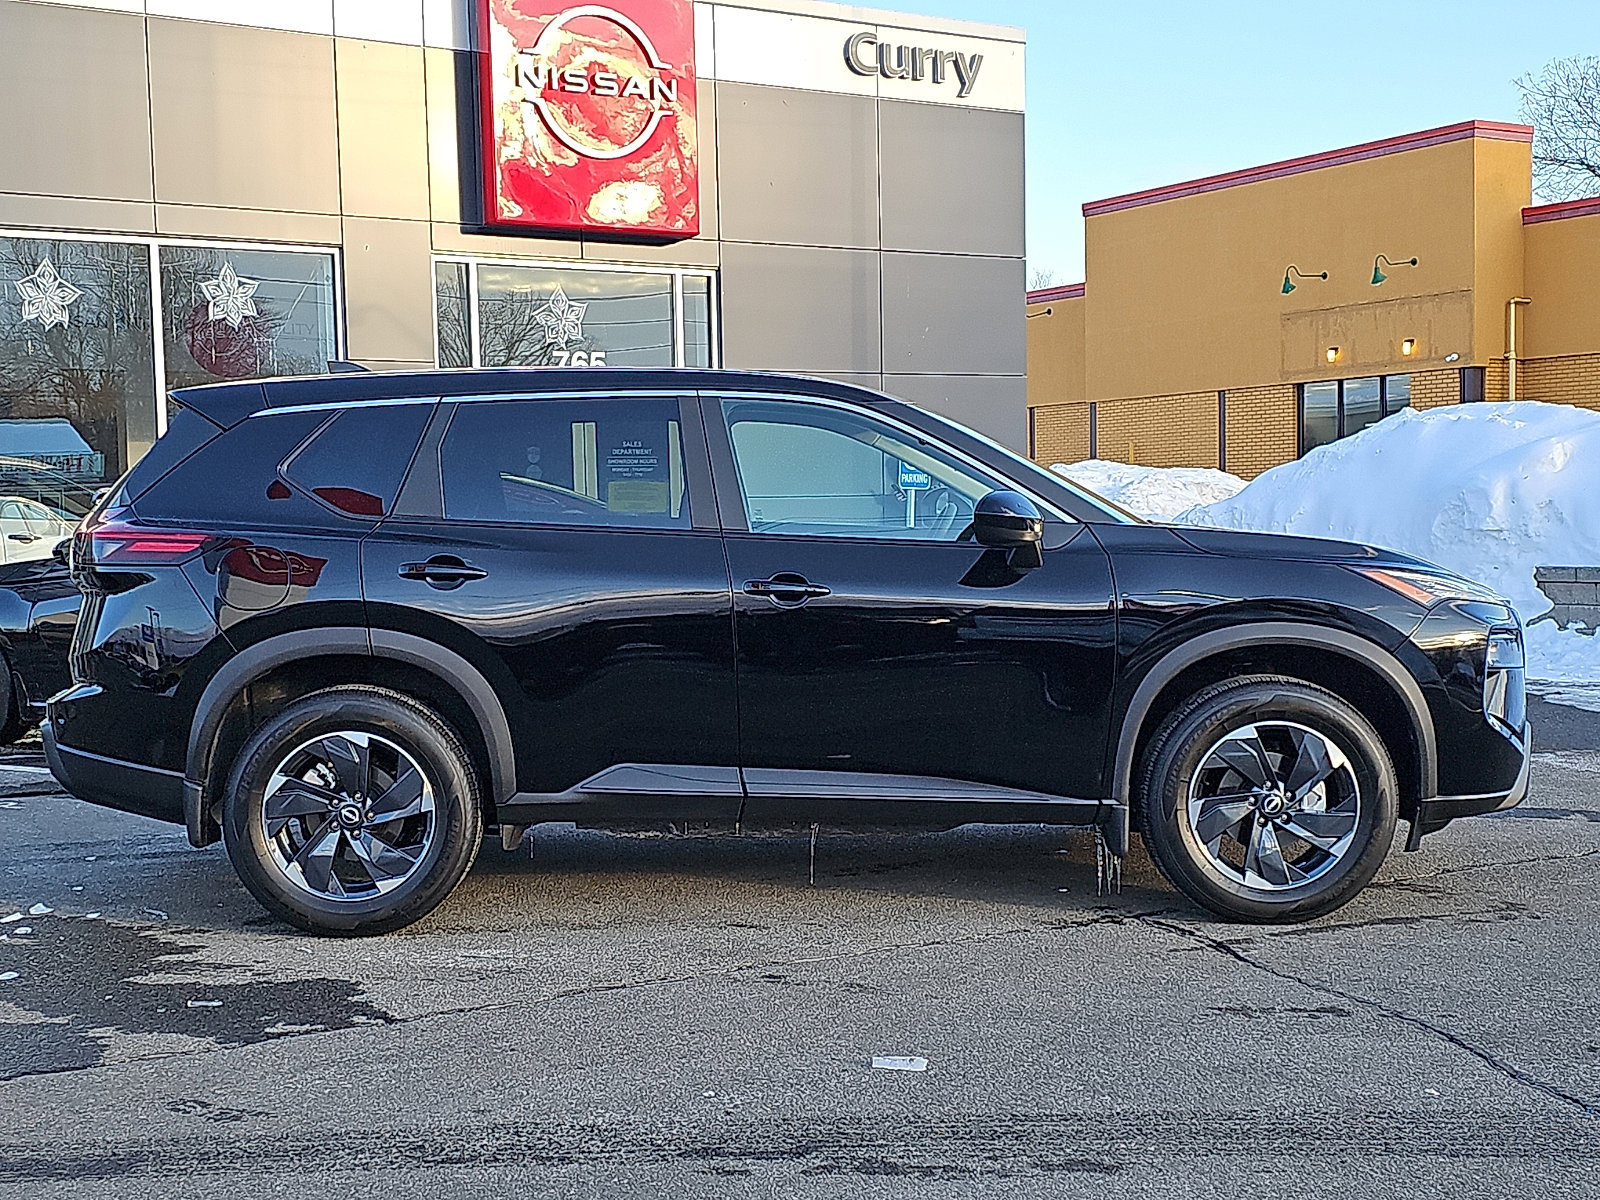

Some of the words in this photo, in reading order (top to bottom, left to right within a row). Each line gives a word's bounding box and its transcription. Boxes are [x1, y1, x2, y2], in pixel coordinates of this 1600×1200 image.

[843, 32, 984, 98] Curry
[515, 62, 678, 102] NISSAN
[552, 350, 607, 367] 765
[901, 473, 928, 484] PARKING
